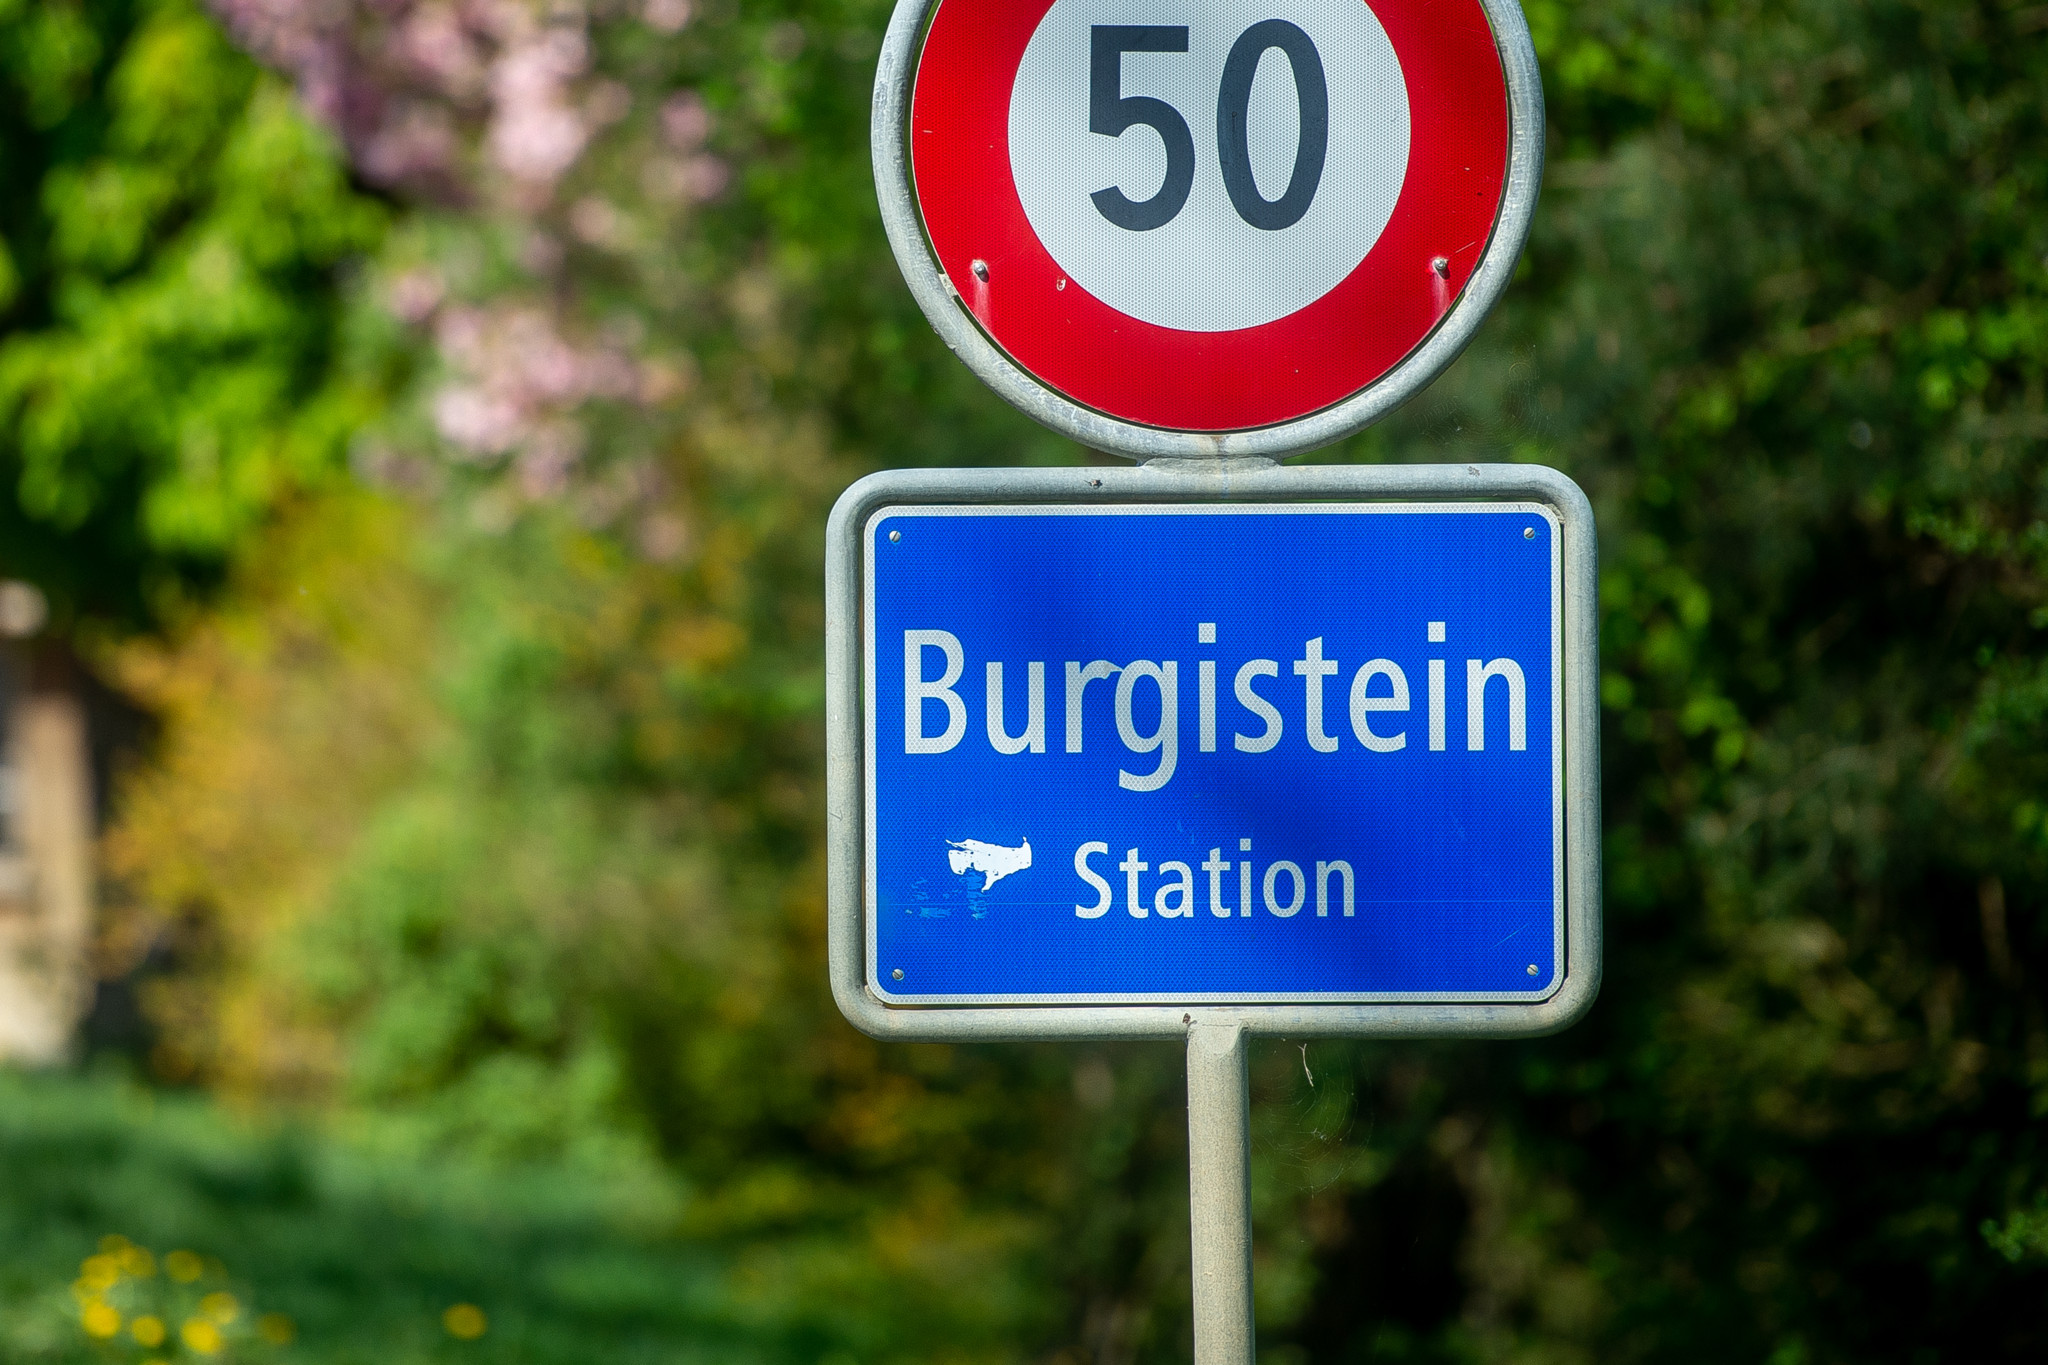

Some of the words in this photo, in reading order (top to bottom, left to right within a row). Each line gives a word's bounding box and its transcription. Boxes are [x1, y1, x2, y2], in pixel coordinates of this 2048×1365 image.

[1089, 18, 1329, 232] 50
[903, 621, 1528, 793] Burgistein
[1074, 837, 1356, 919] Station
